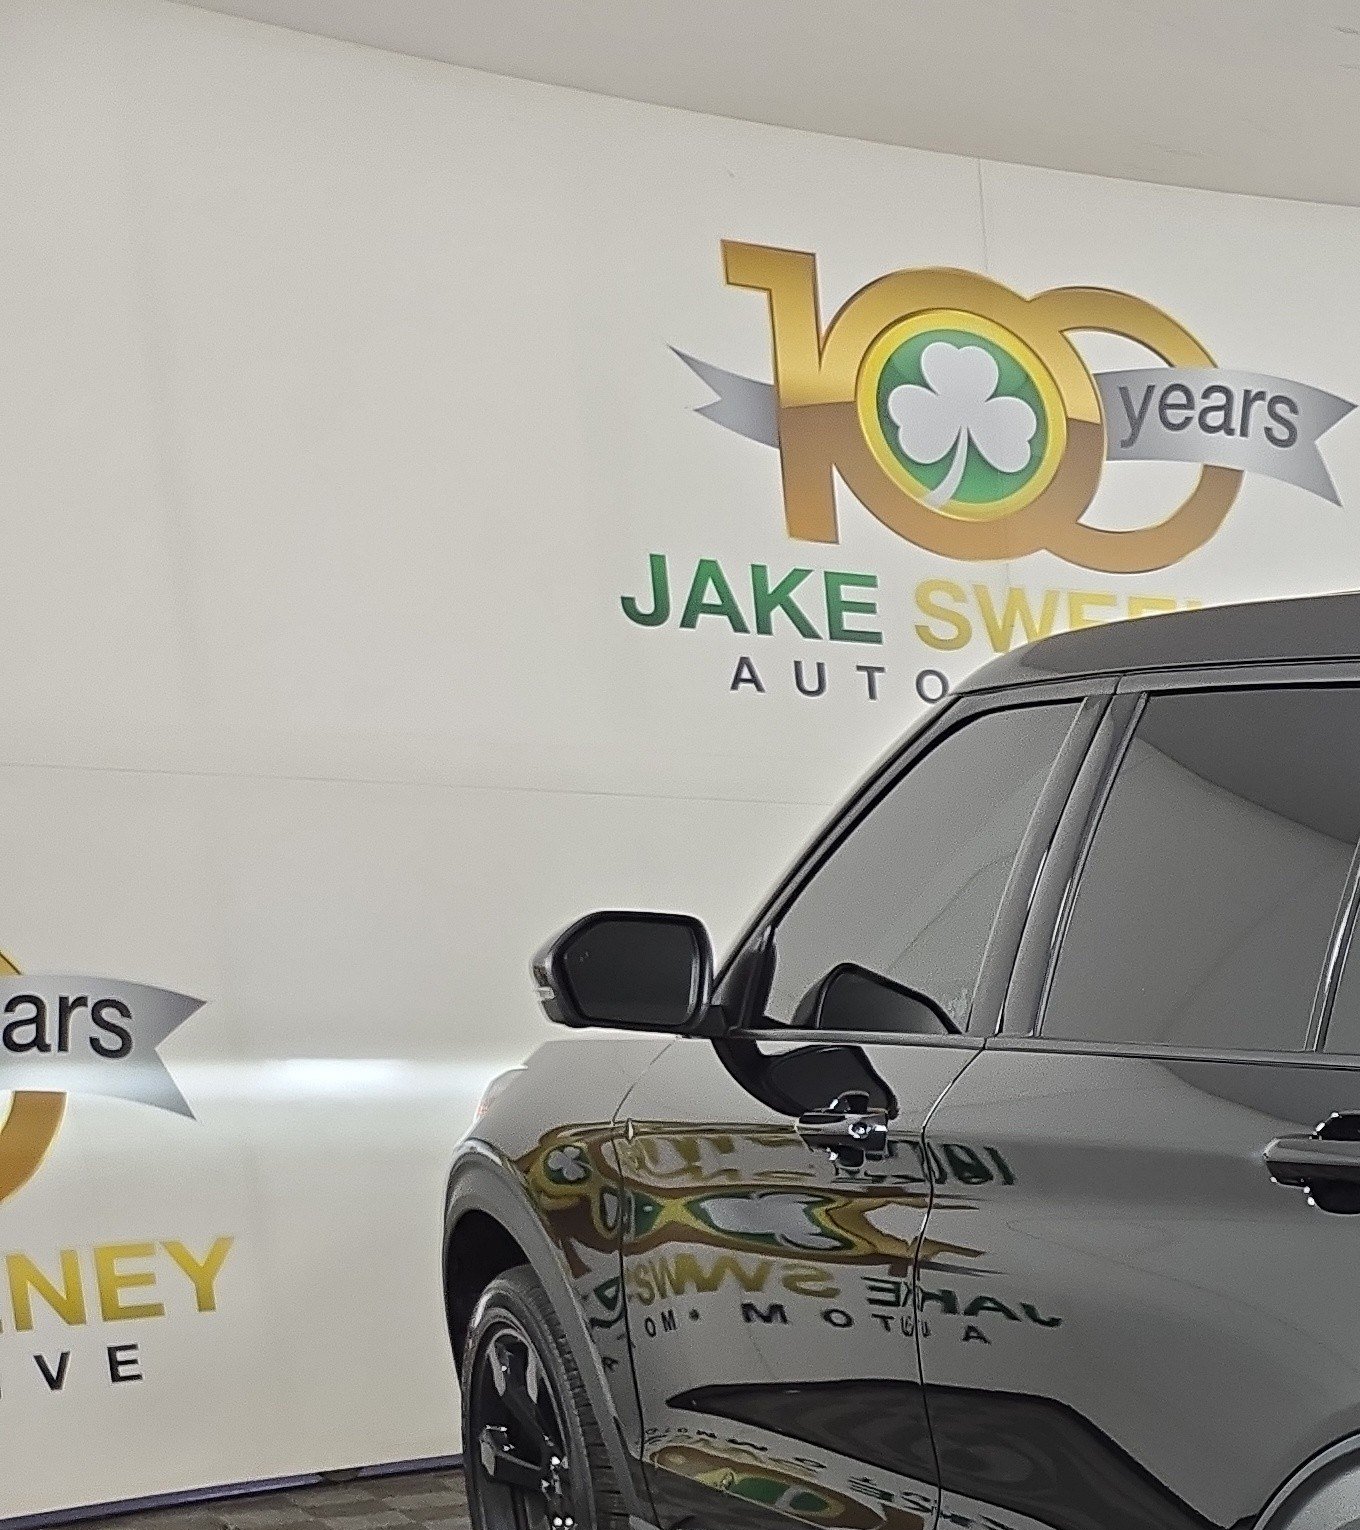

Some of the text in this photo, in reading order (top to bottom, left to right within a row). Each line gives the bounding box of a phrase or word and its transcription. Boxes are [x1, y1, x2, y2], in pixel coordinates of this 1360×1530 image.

[1119, 382, 1300, 449] years
[620, 553, 883, 645] JAKE
[0, 1236, 234, 1332] NEY
